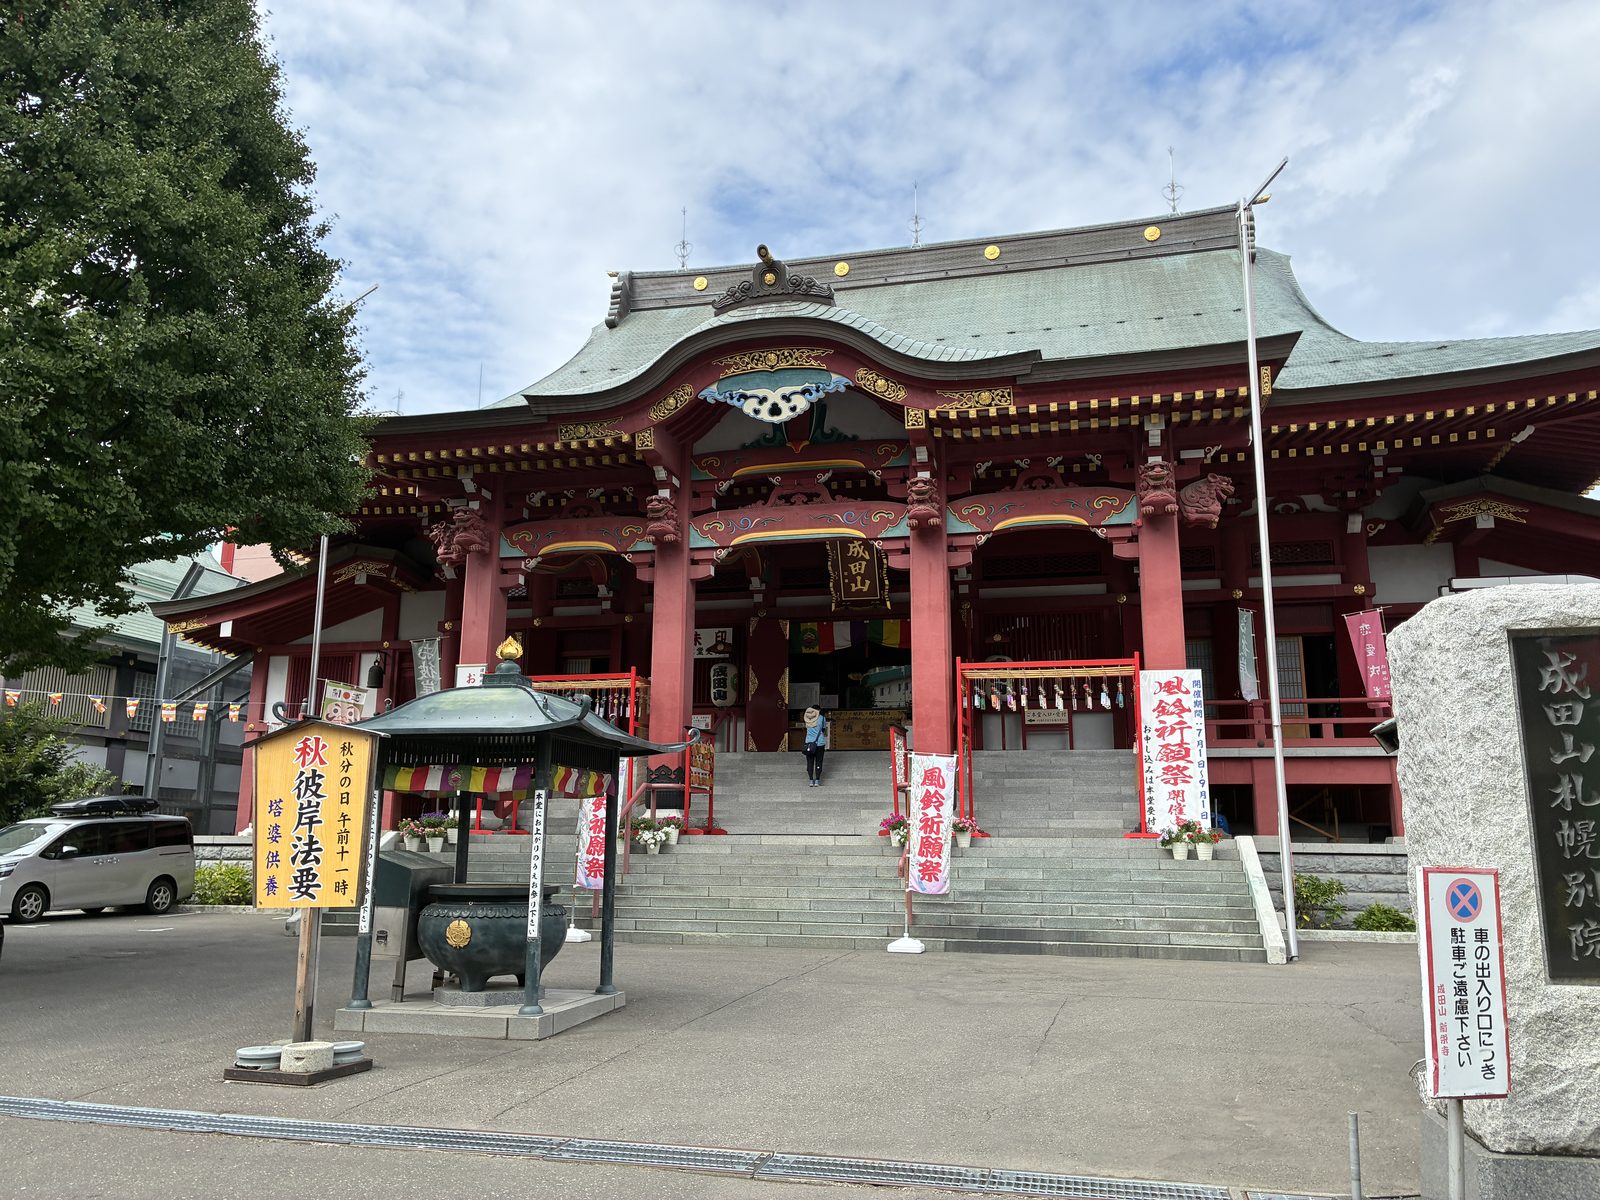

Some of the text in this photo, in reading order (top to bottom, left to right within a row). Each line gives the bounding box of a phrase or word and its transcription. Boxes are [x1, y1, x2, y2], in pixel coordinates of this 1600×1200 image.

[847, 540, 870, 592] 成田山
[712, 665, 728, 701] 成田山
[1152, 675, 1194, 786] 風鈴祈願祭
[265, 798, 284, 897] 塔婆供養
[288, 735, 329, 903] 秋彼岸法要
[334, 741, 354, 896] 秋分の日 午前十一時
[917, 767, 946, 884] 風鈴祈願祭
[1537, 649, 1600, 963] 成田山札幌別院
[1450, 927, 1472, 1068] 駐車ご遠慮下さい
[1473, 928, 1496, 1080] 車の出入り口につき
